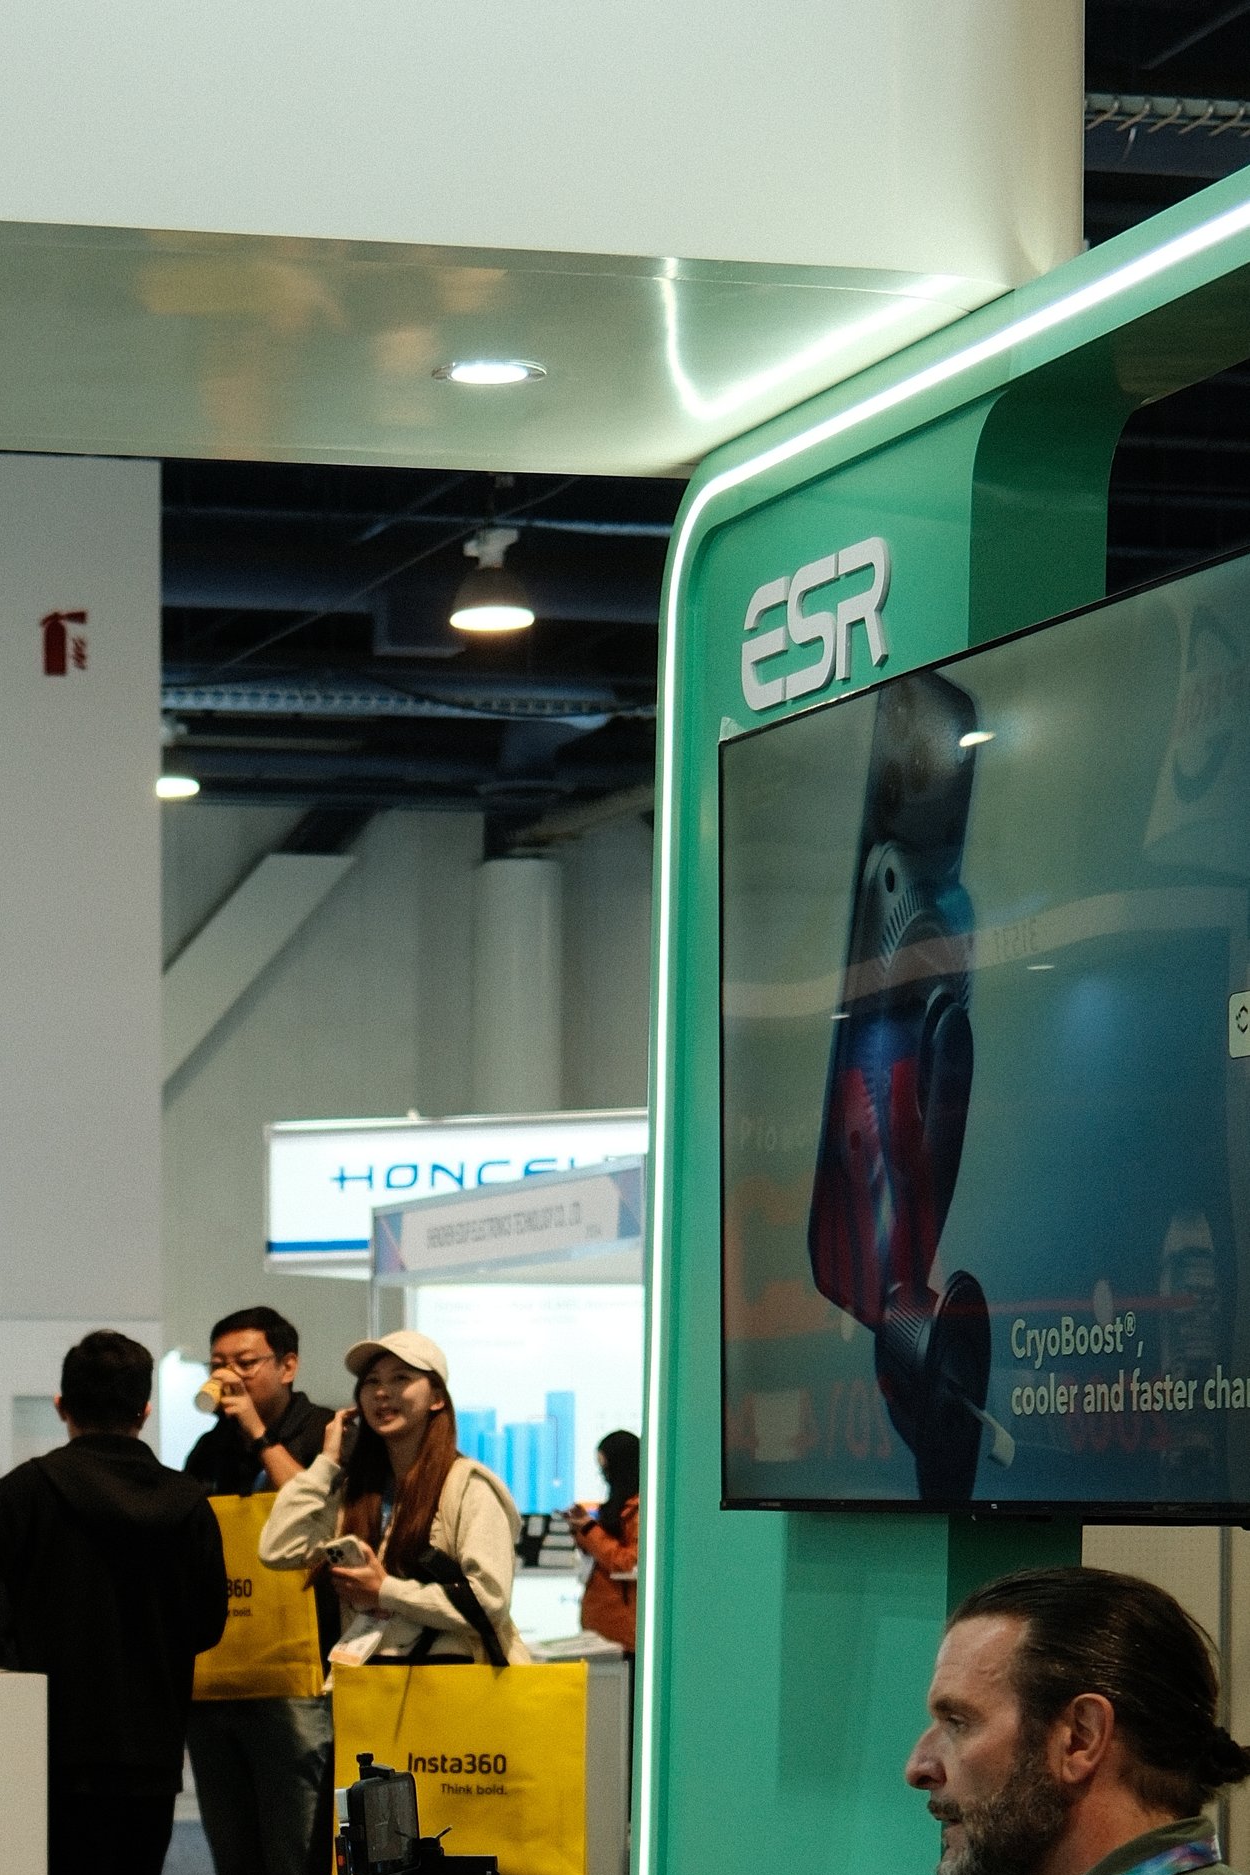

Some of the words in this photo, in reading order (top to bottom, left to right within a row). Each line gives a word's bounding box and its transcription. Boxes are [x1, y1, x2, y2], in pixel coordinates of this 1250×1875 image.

[741, 536, 891, 712] ESR
[331, 1157, 576, 1190] HONCE
[1011, 1373, 1078, 1415] cooler
[1083, 1369, 1124, 1414] and
[1130, 1368, 1198, 1412] faster
[408, 1752, 507, 1775] Insta360
[441, 1783, 472, 1795] Think
[477, 1785, 508, 1796] bold.
